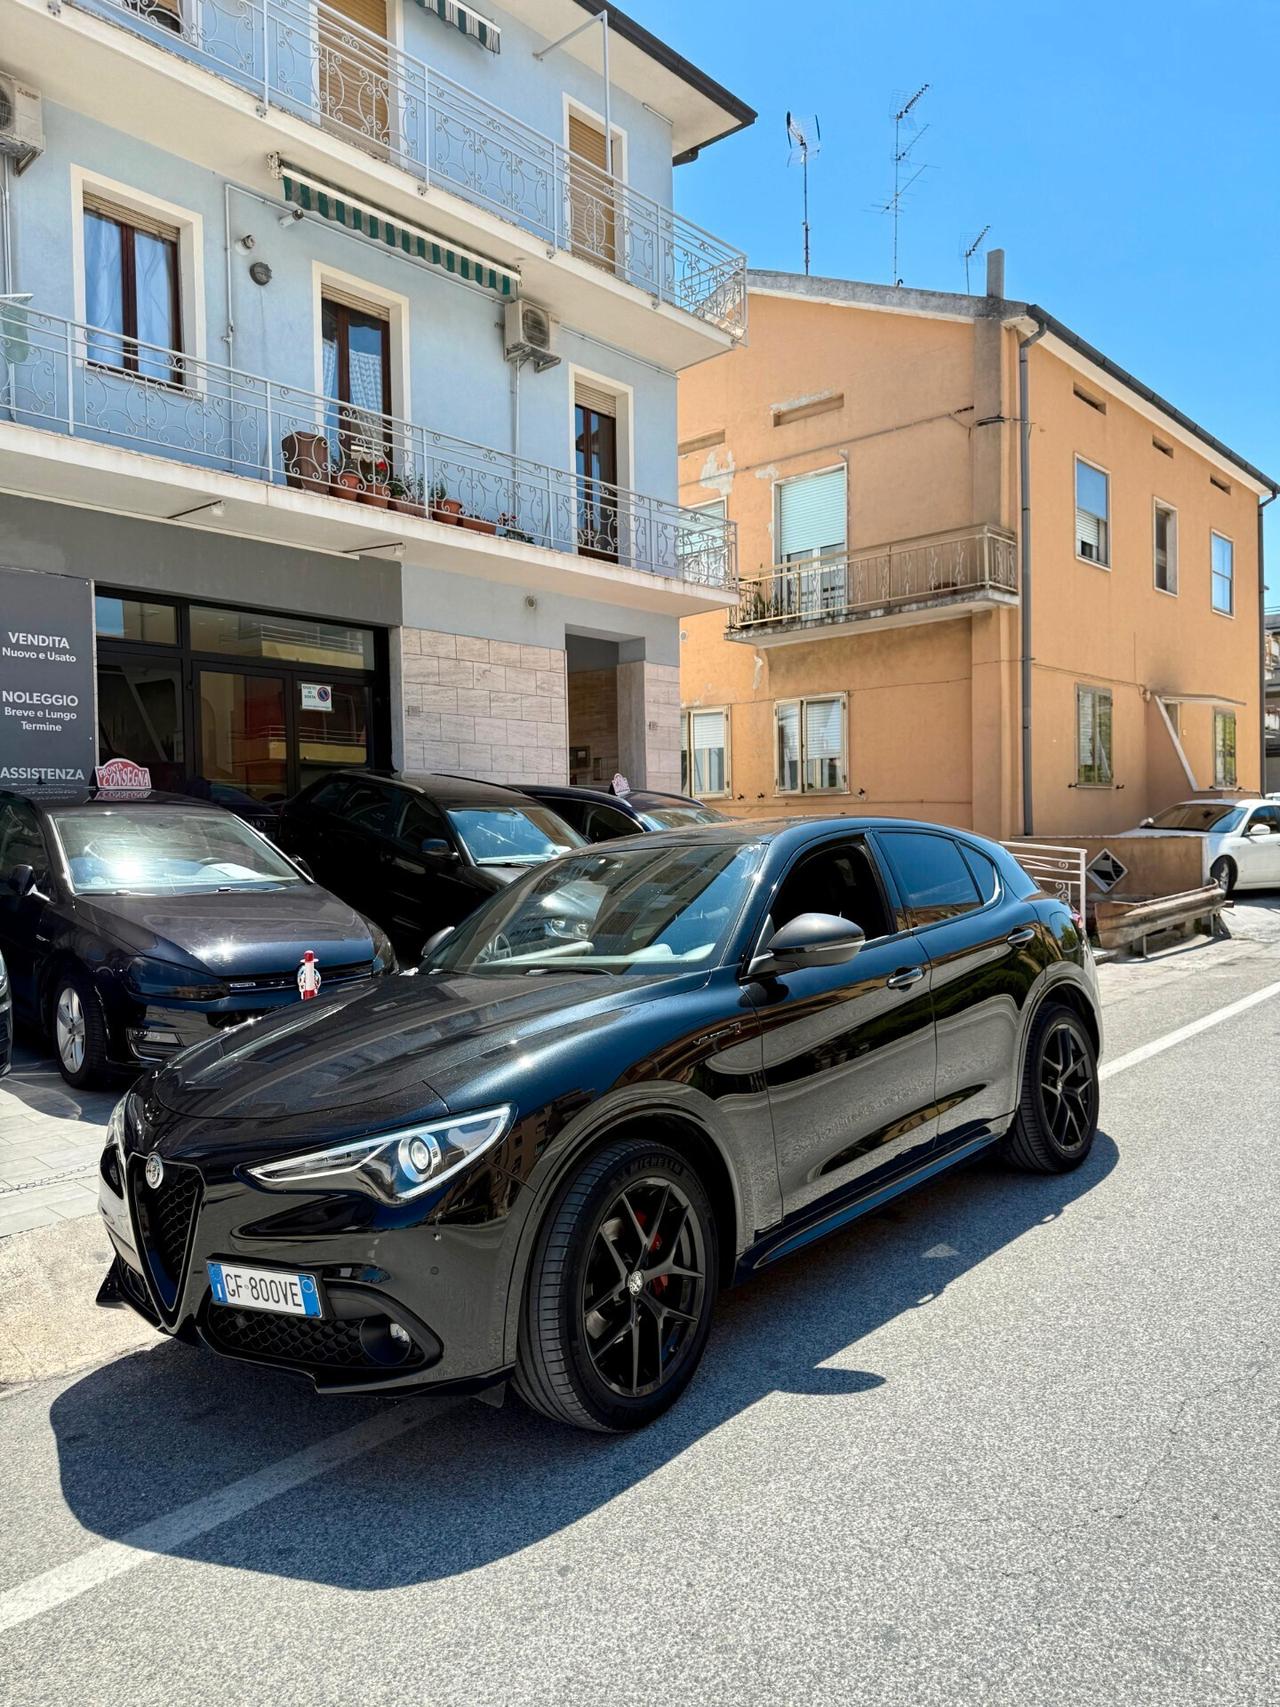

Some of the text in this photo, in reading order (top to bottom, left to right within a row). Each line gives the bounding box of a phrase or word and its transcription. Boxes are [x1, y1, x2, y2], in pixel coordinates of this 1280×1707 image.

[8, 631, 70, 649] VENDITA
[2, 646, 37, 659] Nuovo
[47, 651, 77, 663] Usato
[2, 690, 79, 707] NOLEGGIO
[4, 706, 77, 721] Breve e Lungo
[20, 720, 62, 732] Termine
[0, 766, 85, 780] ASSISTENZA
[98, 762, 124, 778] PRONTA
[102, 766, 149, 787] CONSEGNA
